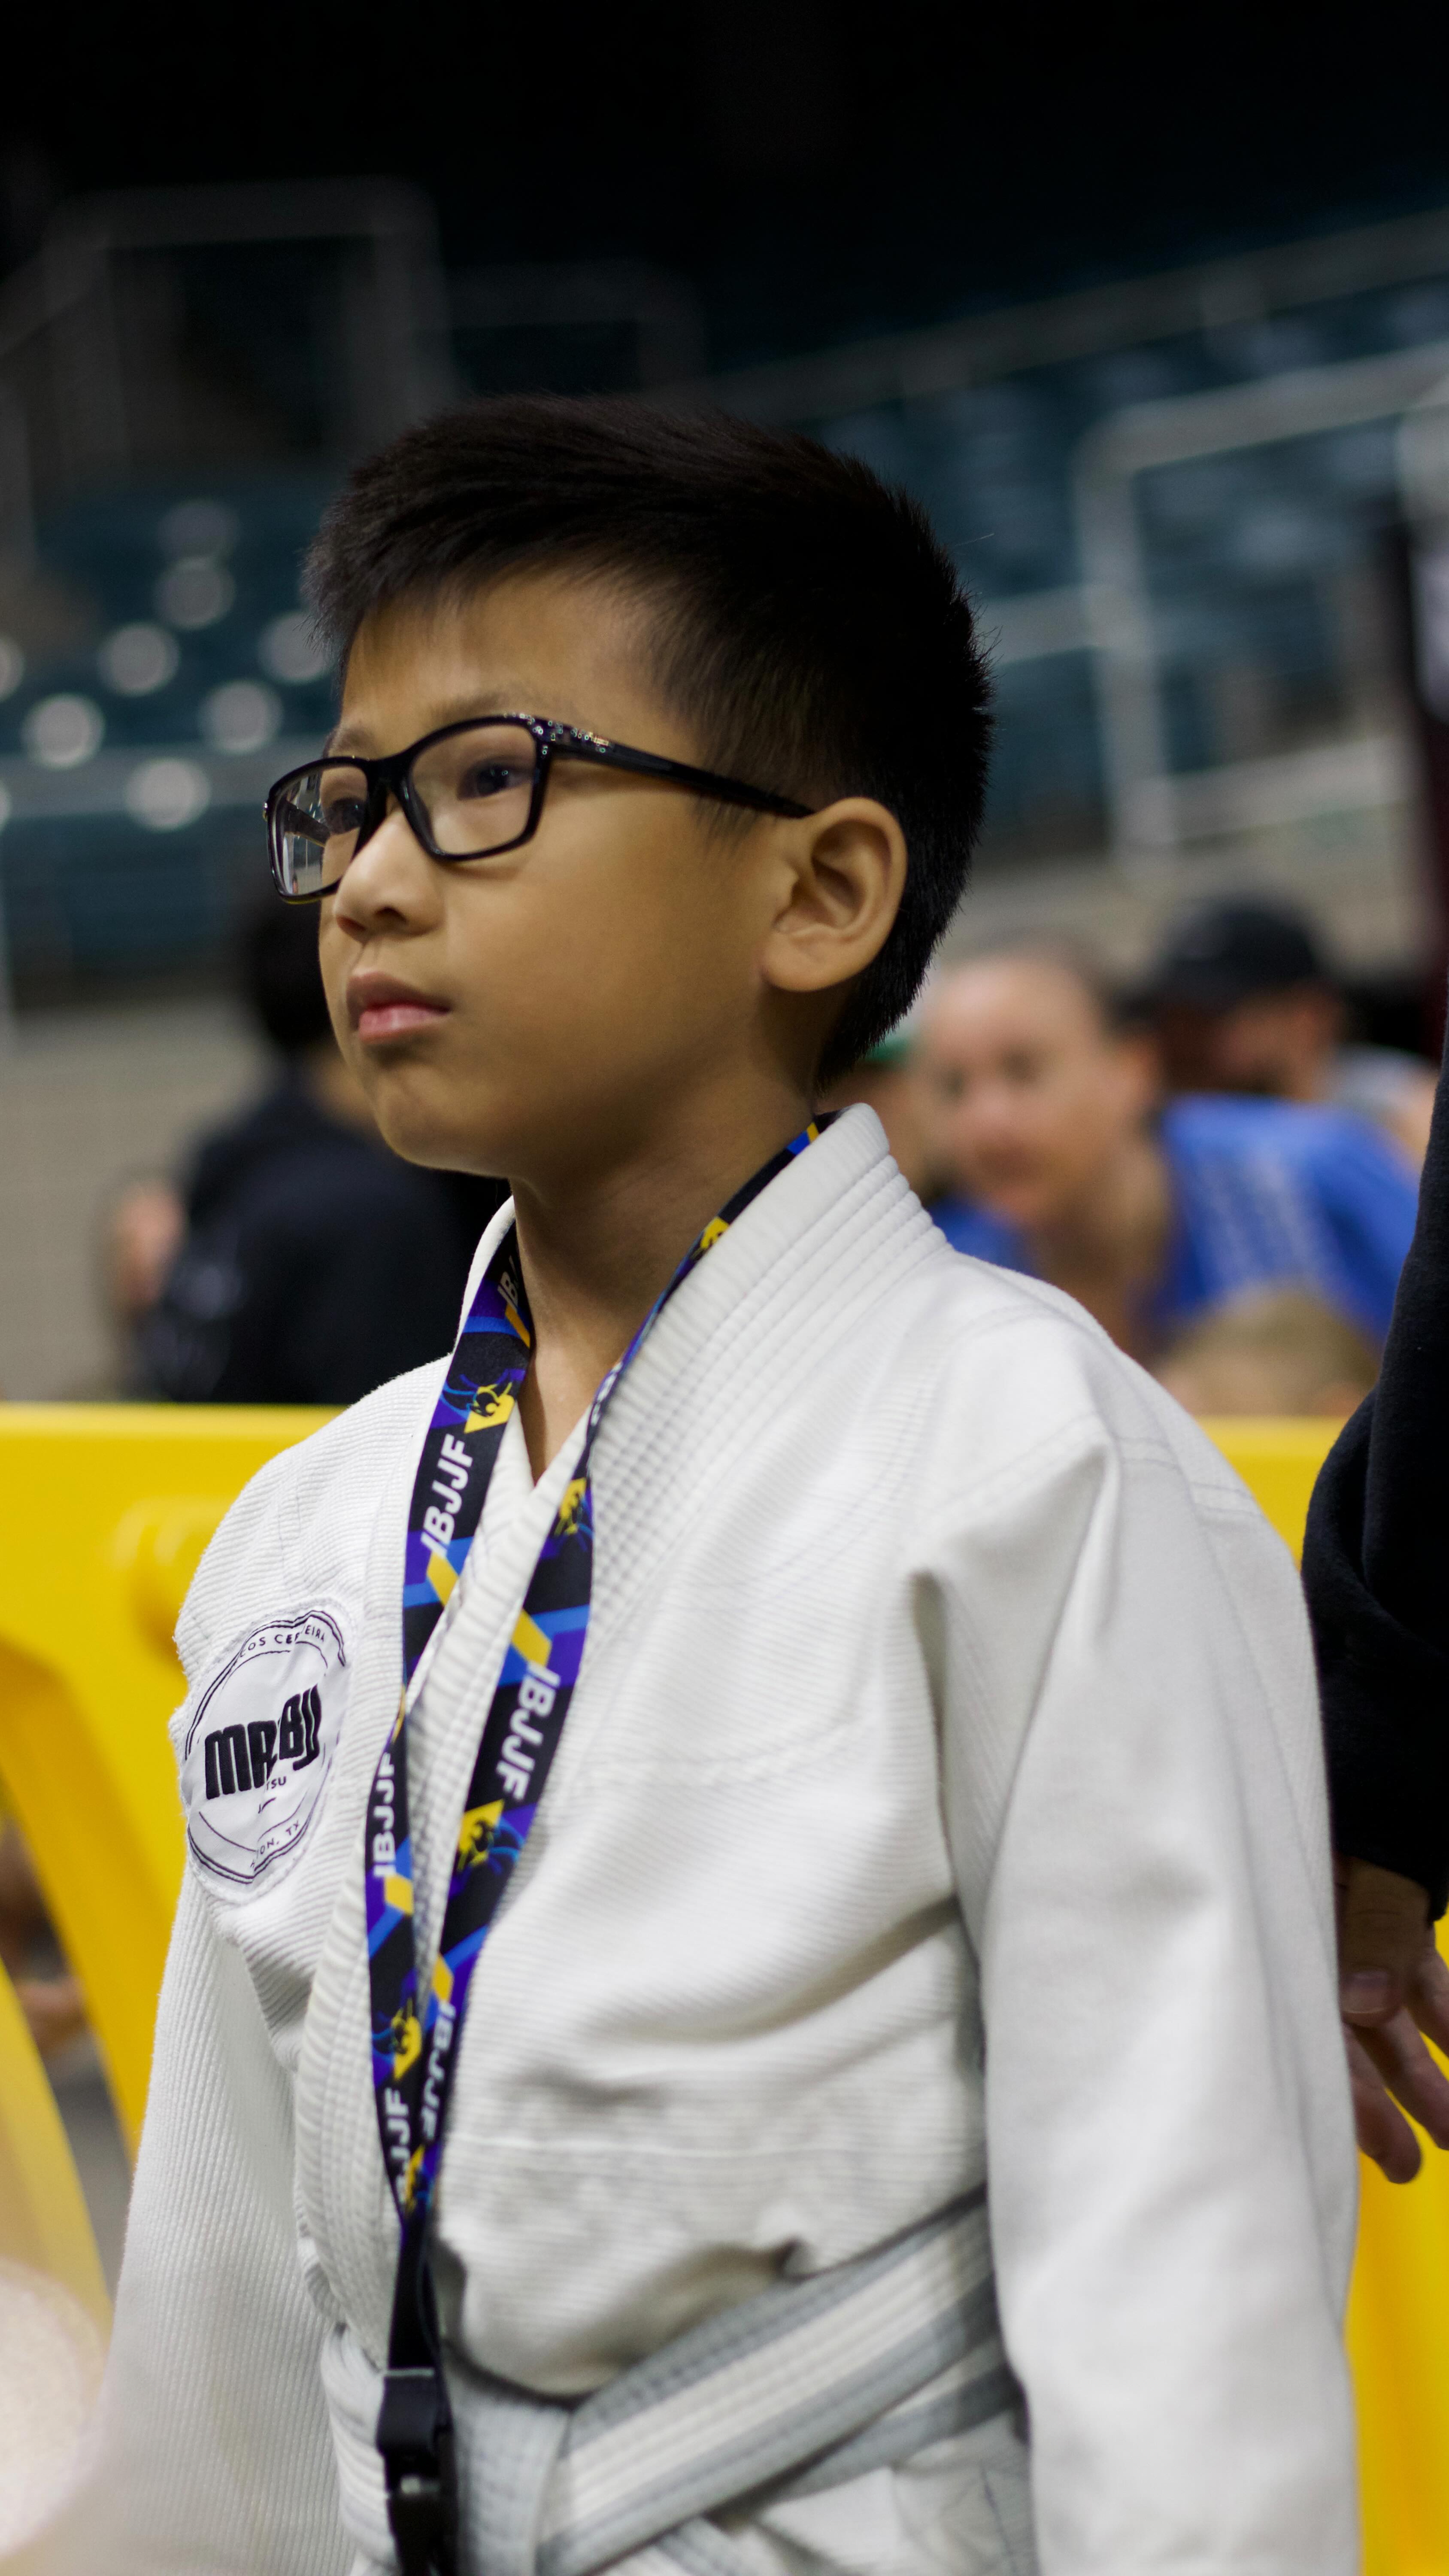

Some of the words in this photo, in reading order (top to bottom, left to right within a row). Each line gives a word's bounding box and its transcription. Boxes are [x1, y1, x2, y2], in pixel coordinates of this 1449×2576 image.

[421, 1434, 474, 1557] IBJJF
[497, 1661, 560, 1801] IBJJF
[285, 1820, 299, 1836] TX
[373, 1752, 396, 1877] IBJJF
[421, 2001, 456, 2140] IBJJF
